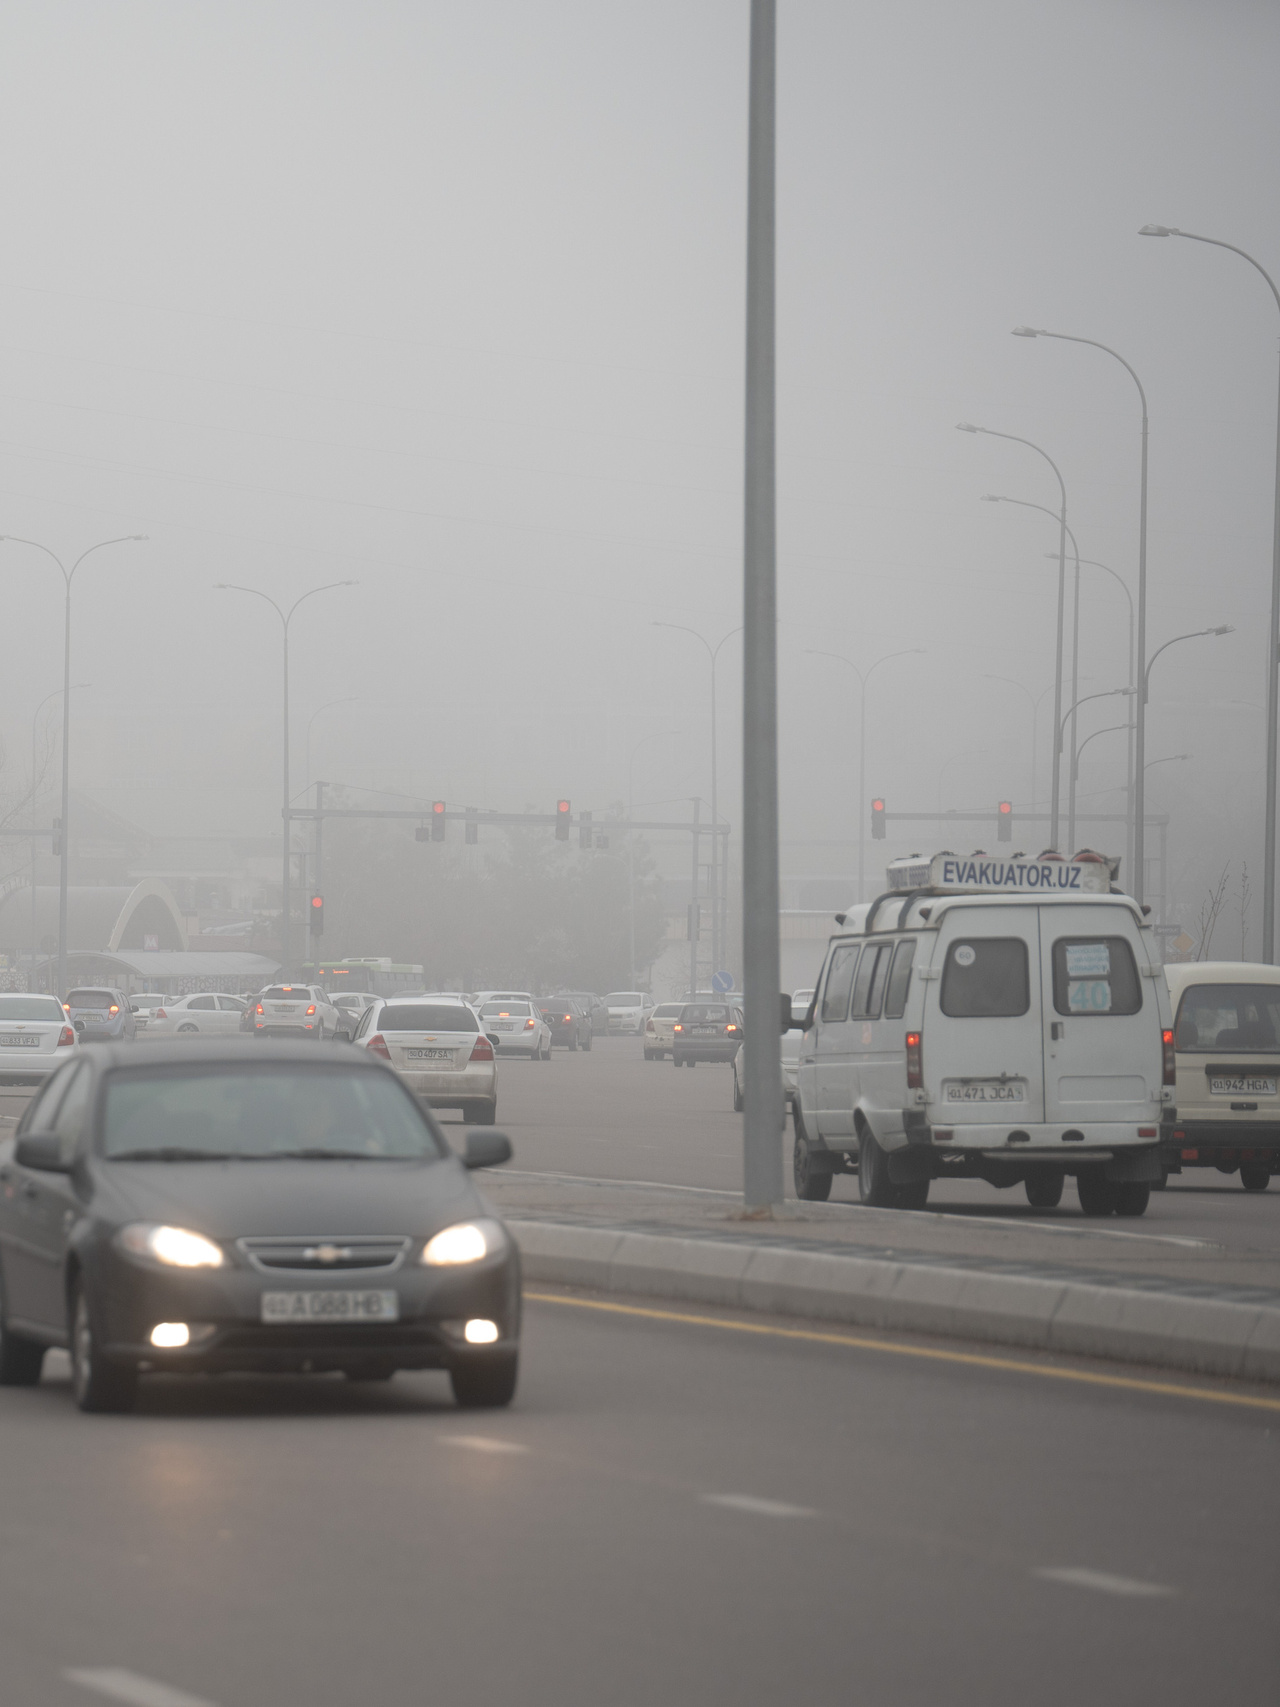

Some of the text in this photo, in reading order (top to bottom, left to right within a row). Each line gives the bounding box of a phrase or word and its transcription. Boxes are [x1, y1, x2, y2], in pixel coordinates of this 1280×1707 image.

[943, 861, 1082, 889] EVAKUATOR.UZ
[1070, 982, 1108, 1010] 40
[964, 1087, 986, 1100] 471
[989, 1087, 1015, 1100] JCA
[1226, 1080, 1245, 1090] 942
[1247, 1080, 1269, 1090] HGA
